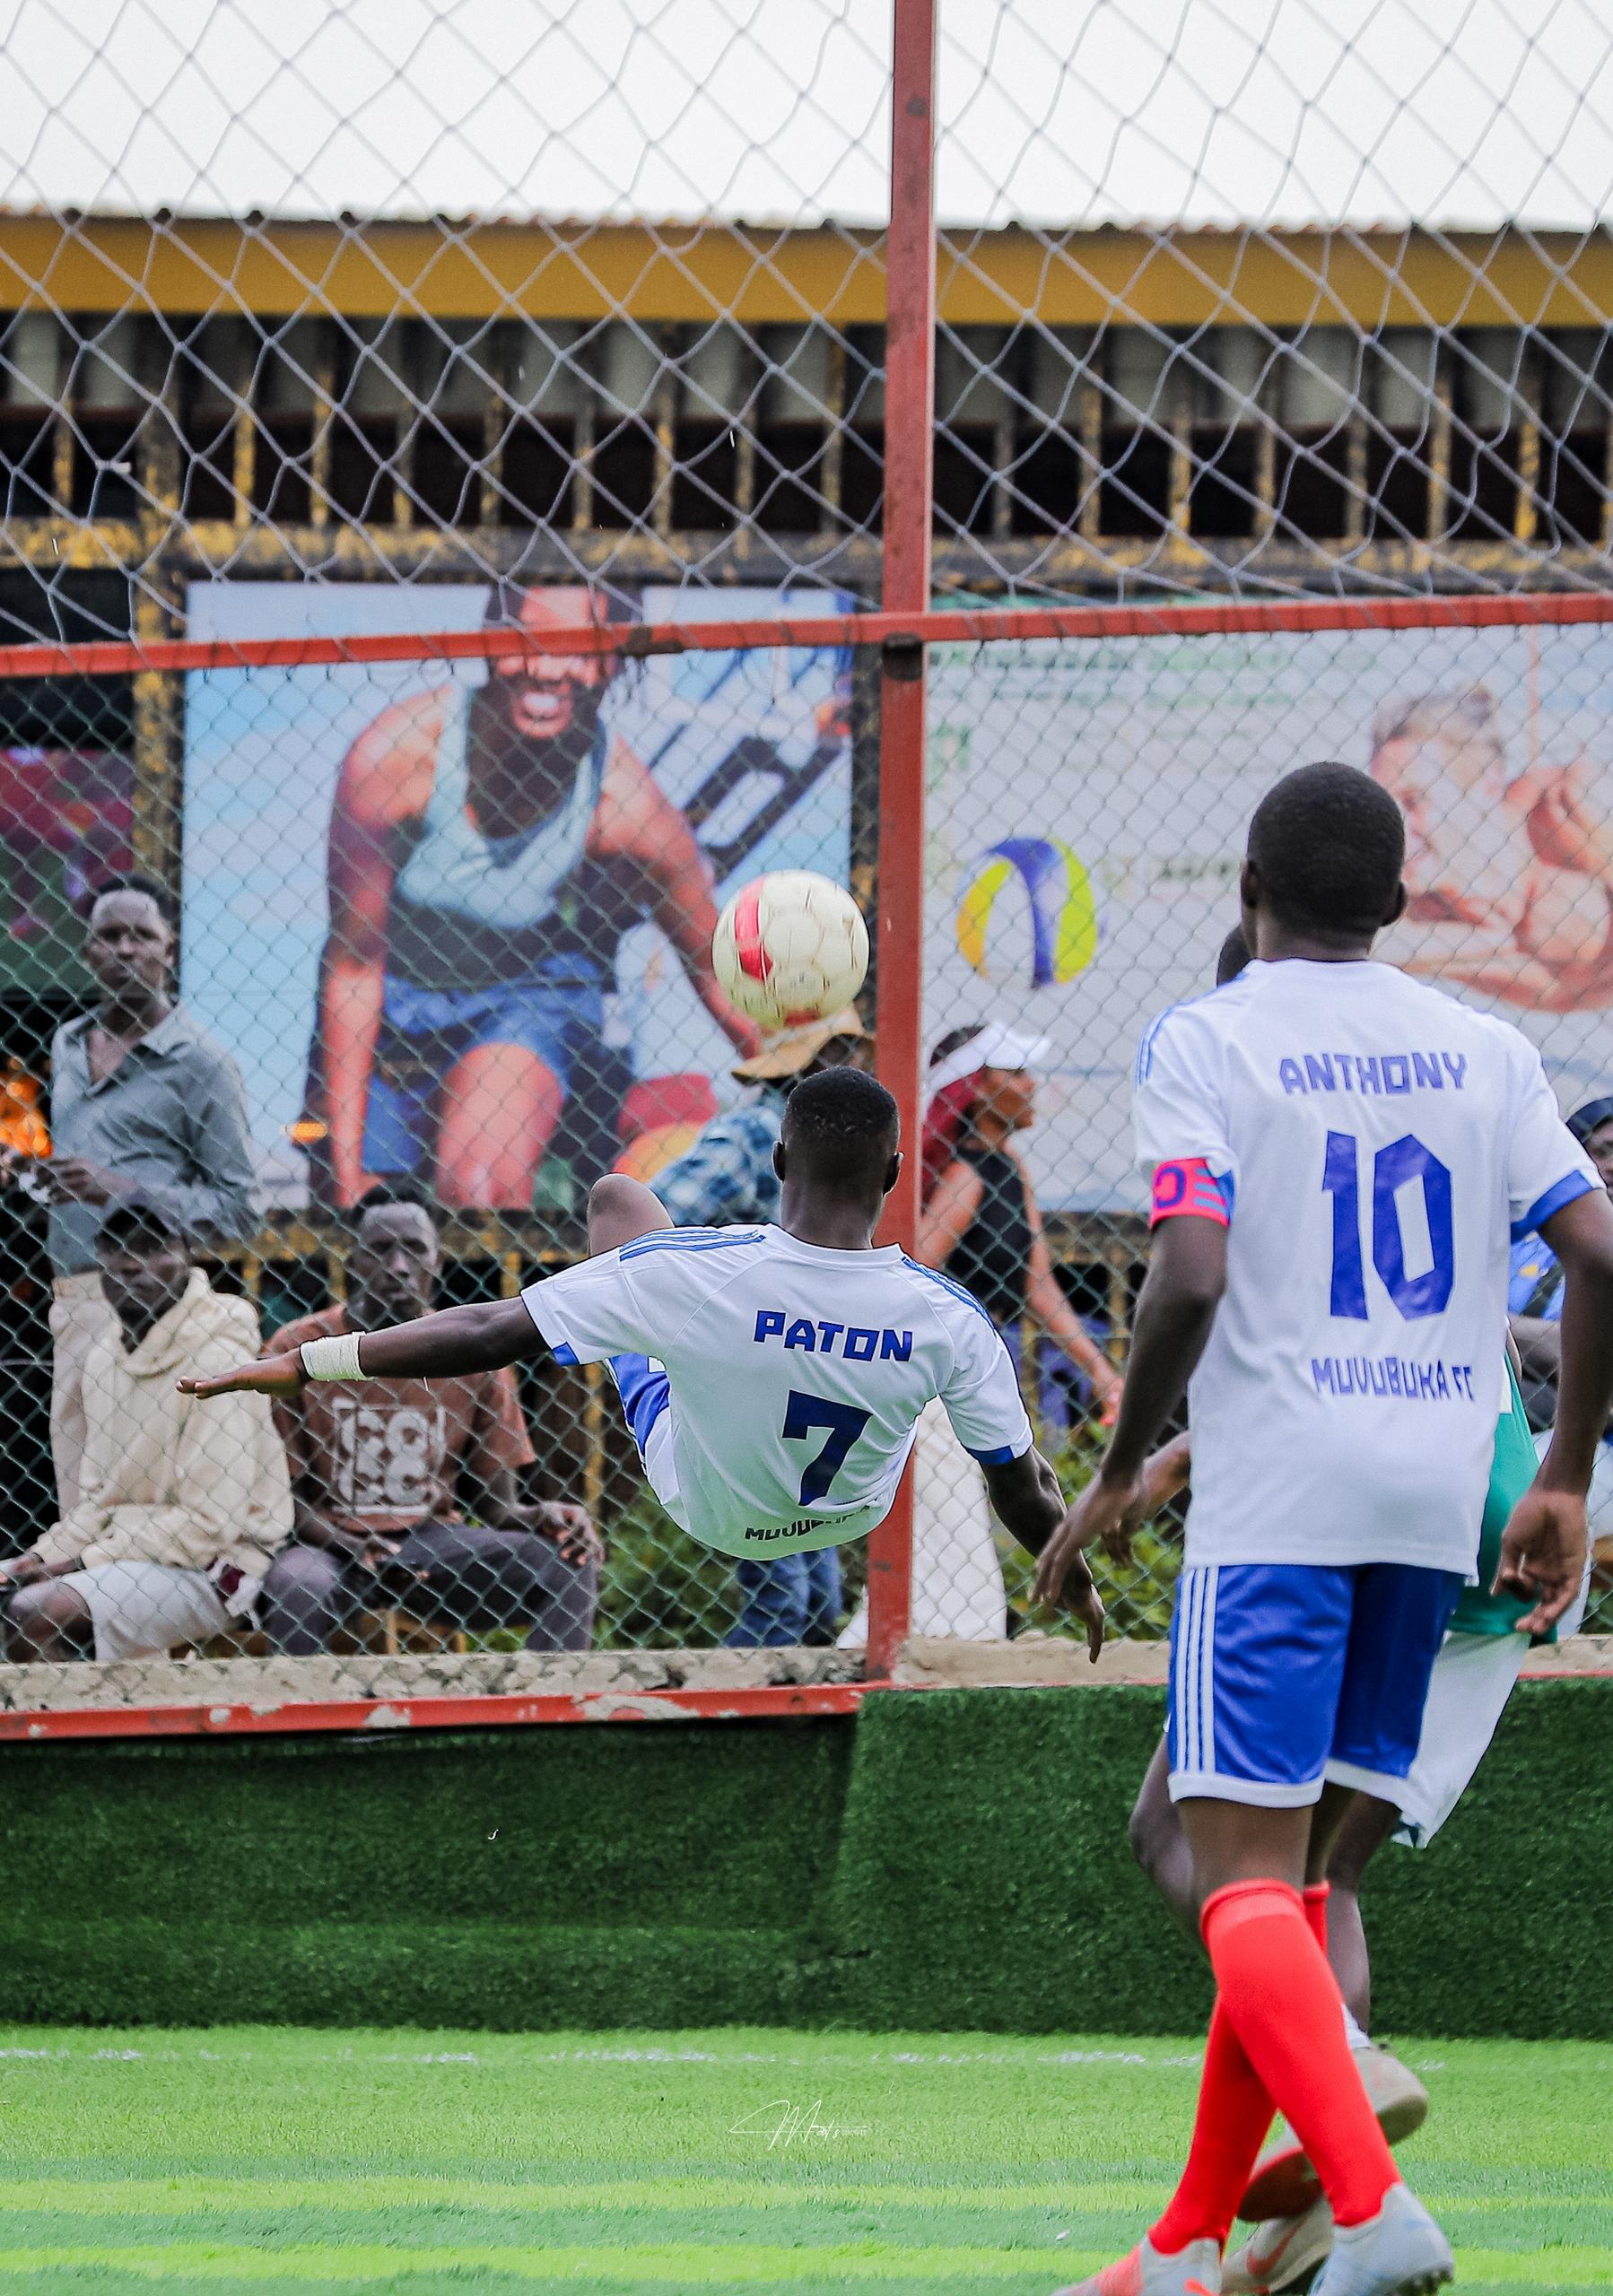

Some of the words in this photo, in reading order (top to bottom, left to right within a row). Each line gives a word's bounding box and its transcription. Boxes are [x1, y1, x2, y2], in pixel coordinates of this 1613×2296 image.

[1279, 1052, 1468, 1095] ANTHONY
[1321, 1130, 1454, 1321] 10
[754, 1309, 913, 1362] PATON
[1312, 1356, 1451, 1400] MUVUBUKA
[781, 1388, 875, 1507] 7
